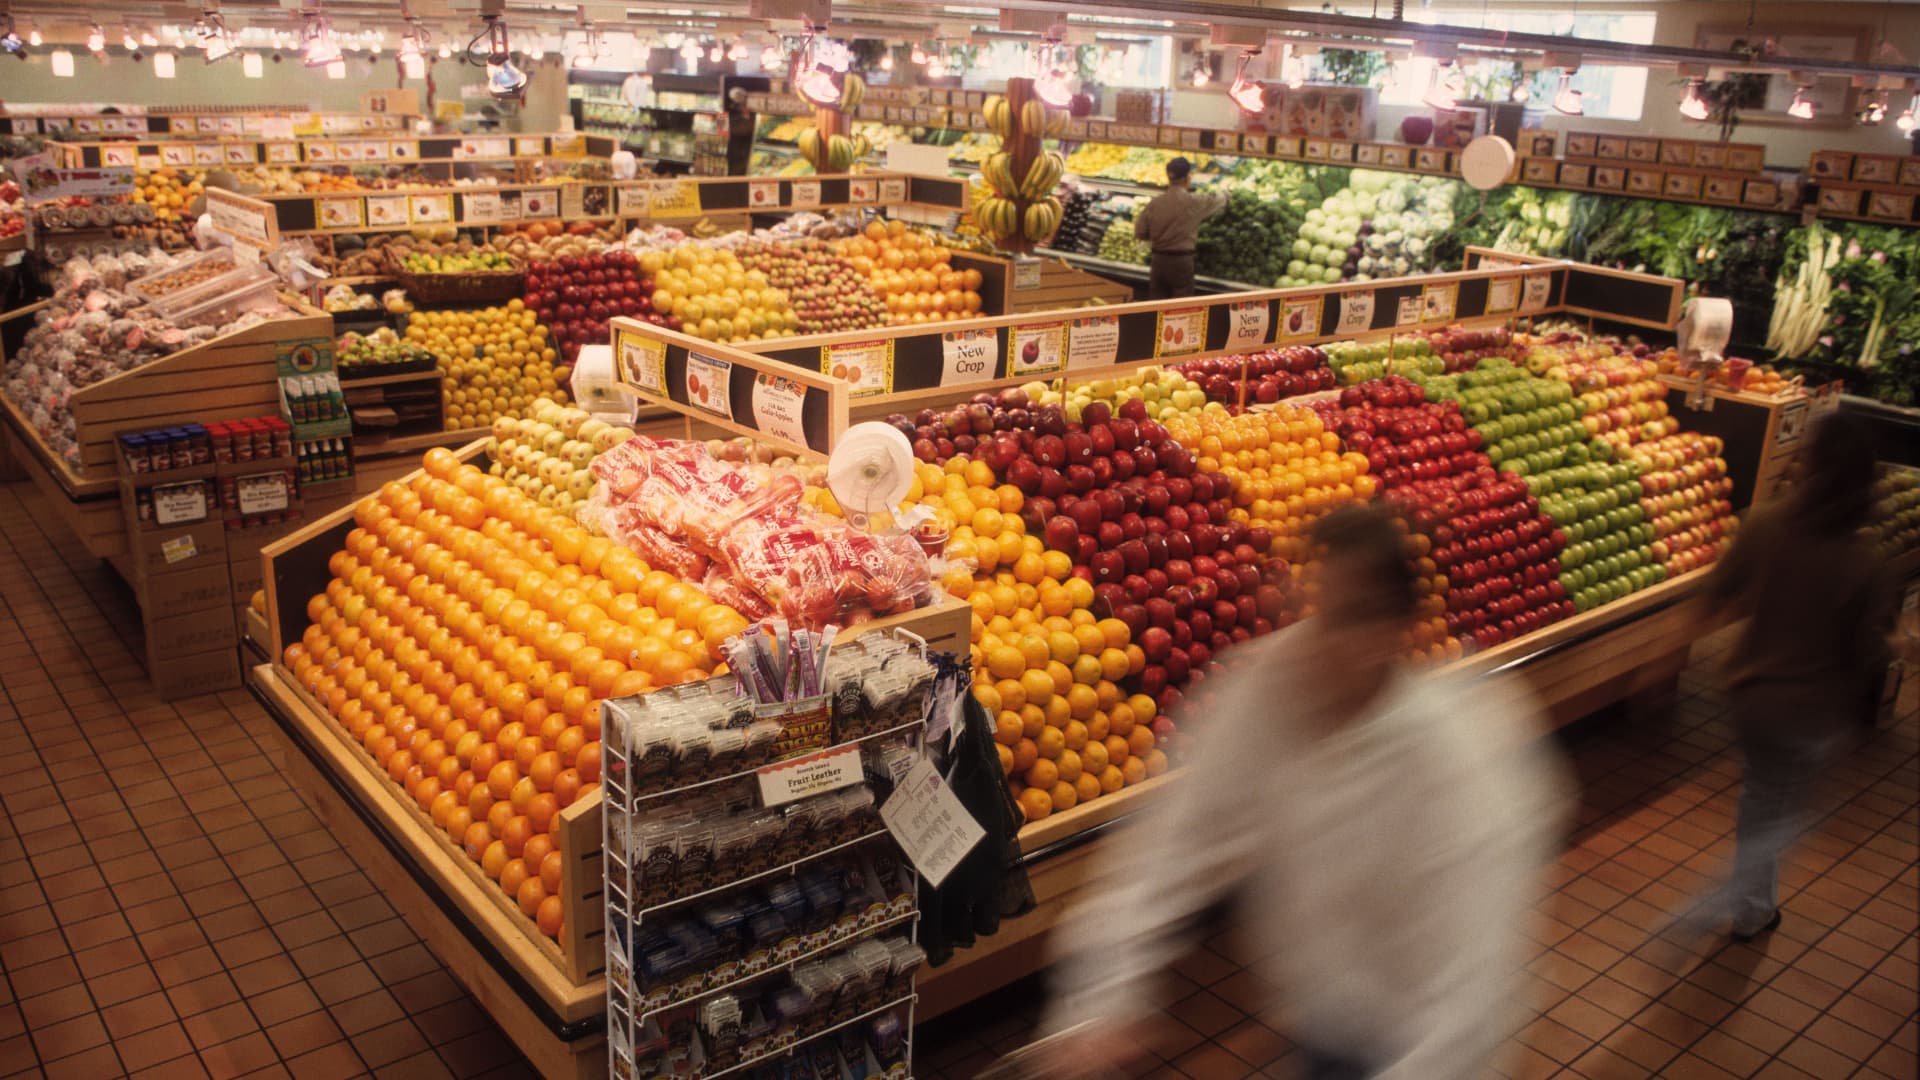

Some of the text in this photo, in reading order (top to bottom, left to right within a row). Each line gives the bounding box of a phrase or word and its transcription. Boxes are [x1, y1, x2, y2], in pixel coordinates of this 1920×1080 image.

[472, 207, 492, 218] Crop
[1349, 302, 1366, 313] New
[1240, 313, 1261, 326] New
[1346, 314, 1366, 326] Crop
[1238, 327, 1260, 339] Crop
[958, 345, 985, 359] New
[1008, 325, 1017, 378] ORGANIC
[886, 338, 894, 394] ORGANIC
[956, 360, 985, 374] Crop
[788, 776, 810, 788] Fruit
[811, 768, 842, 781] Leather
